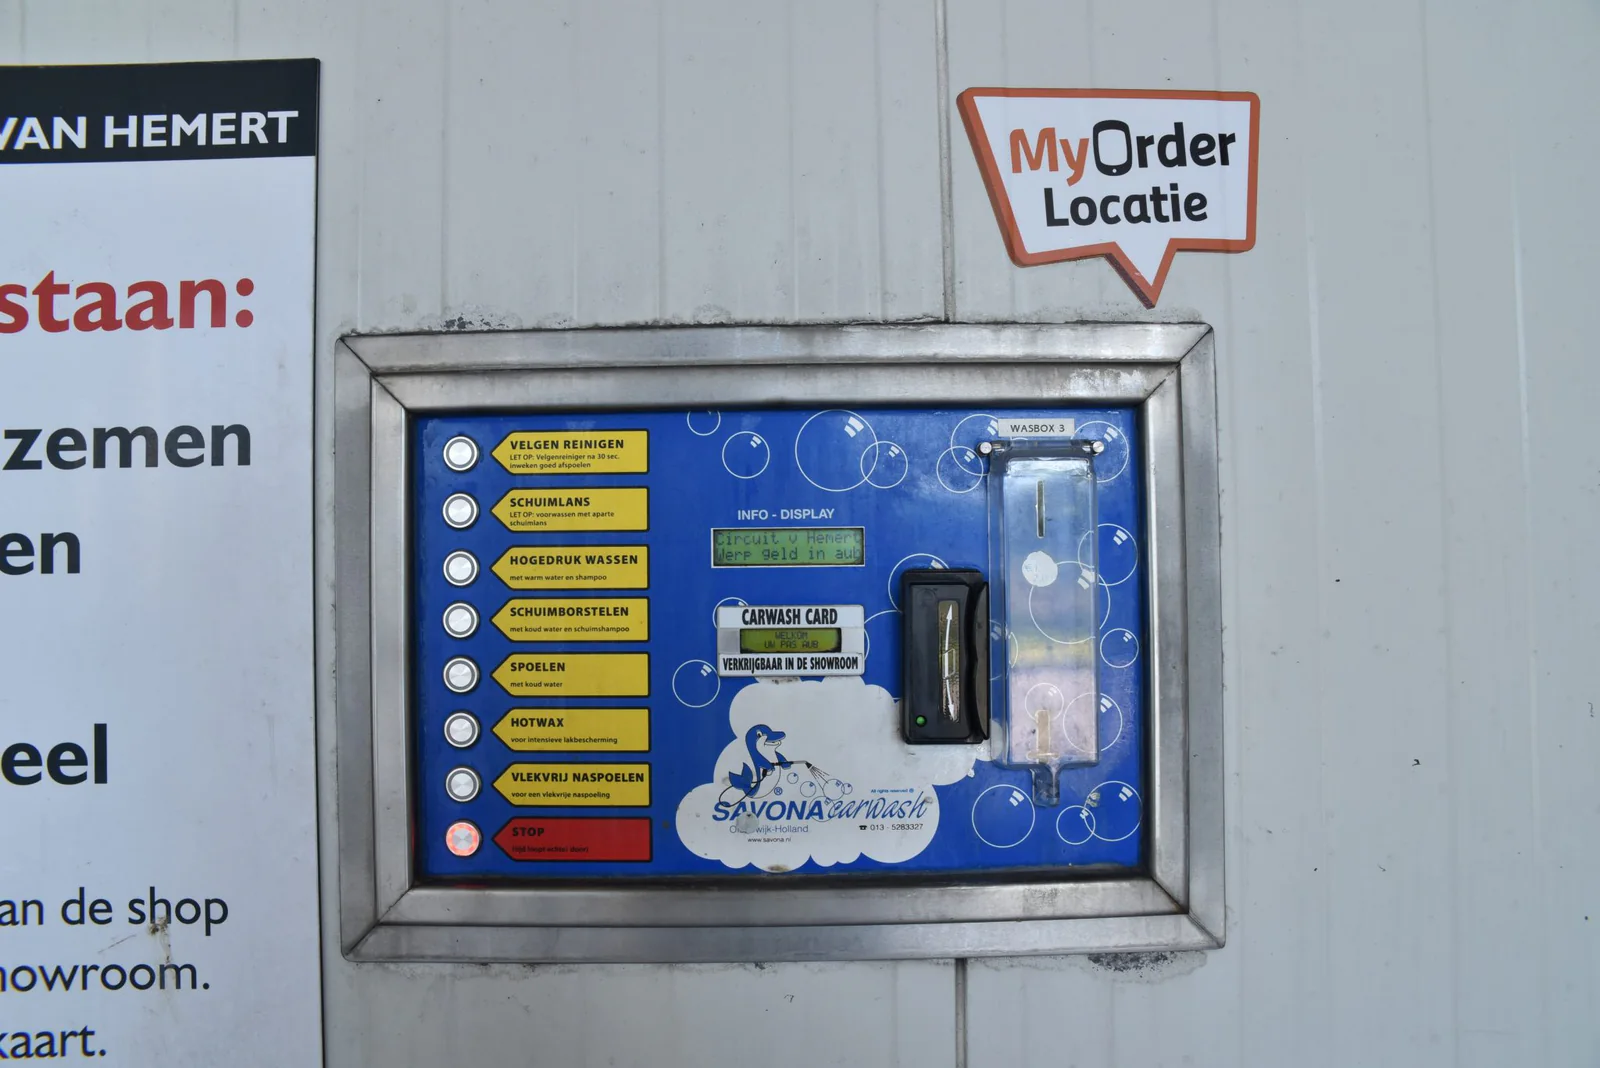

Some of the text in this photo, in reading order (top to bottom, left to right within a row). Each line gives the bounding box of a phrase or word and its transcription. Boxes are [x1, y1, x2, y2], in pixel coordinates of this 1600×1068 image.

[104, 110, 299, 149] HEMERT
[1009, 119, 1236, 186] MyOrder
[1044, 183, 1208, 227] Locatie
[1010, 424, 1055, 433] WASBOX
[2, 422, 252, 470] zemen
[510, 439, 624, 450] VELGEN REINIGEN
[536, 453, 585, 461] Velgenreiniger
[510, 497, 590, 507] SCHUIMLANS
[738, 509, 768, 520] INFO
[781, 509, 835, 520] DISPLAY
[510, 519, 547, 527] schuimlans
[716, 531, 779, 546] Circuit
[762, 548, 798, 559] geld
[809, 548, 825, 560] in
[510, 555, 638, 565] HOGEDRUK WASSEN
[510, 607, 629, 616] SCHUIMBORSTELEN
[742, 608, 838, 625] CARWASH CARD
[511, 662, 565, 672] SPOELEN
[723, 657, 858, 673] VERKRIJGBAAR IN DE SHOWROOM
[511, 718, 564, 728] HOTWAX
[564, 736, 618, 744] lakbescherming
[0, 723, 107, 785] eel
[512, 773, 644, 783] VLEKVRIJ NASPOELEN
[573, 791, 610, 799] naspoeling
[712, 800, 824, 821] SAVONA
[512, 827, 544, 836] STOP
[730, 824, 809, 834] Owijk-Holland
[61, 887, 113, 926] de
[128, 886, 228, 936] shop
